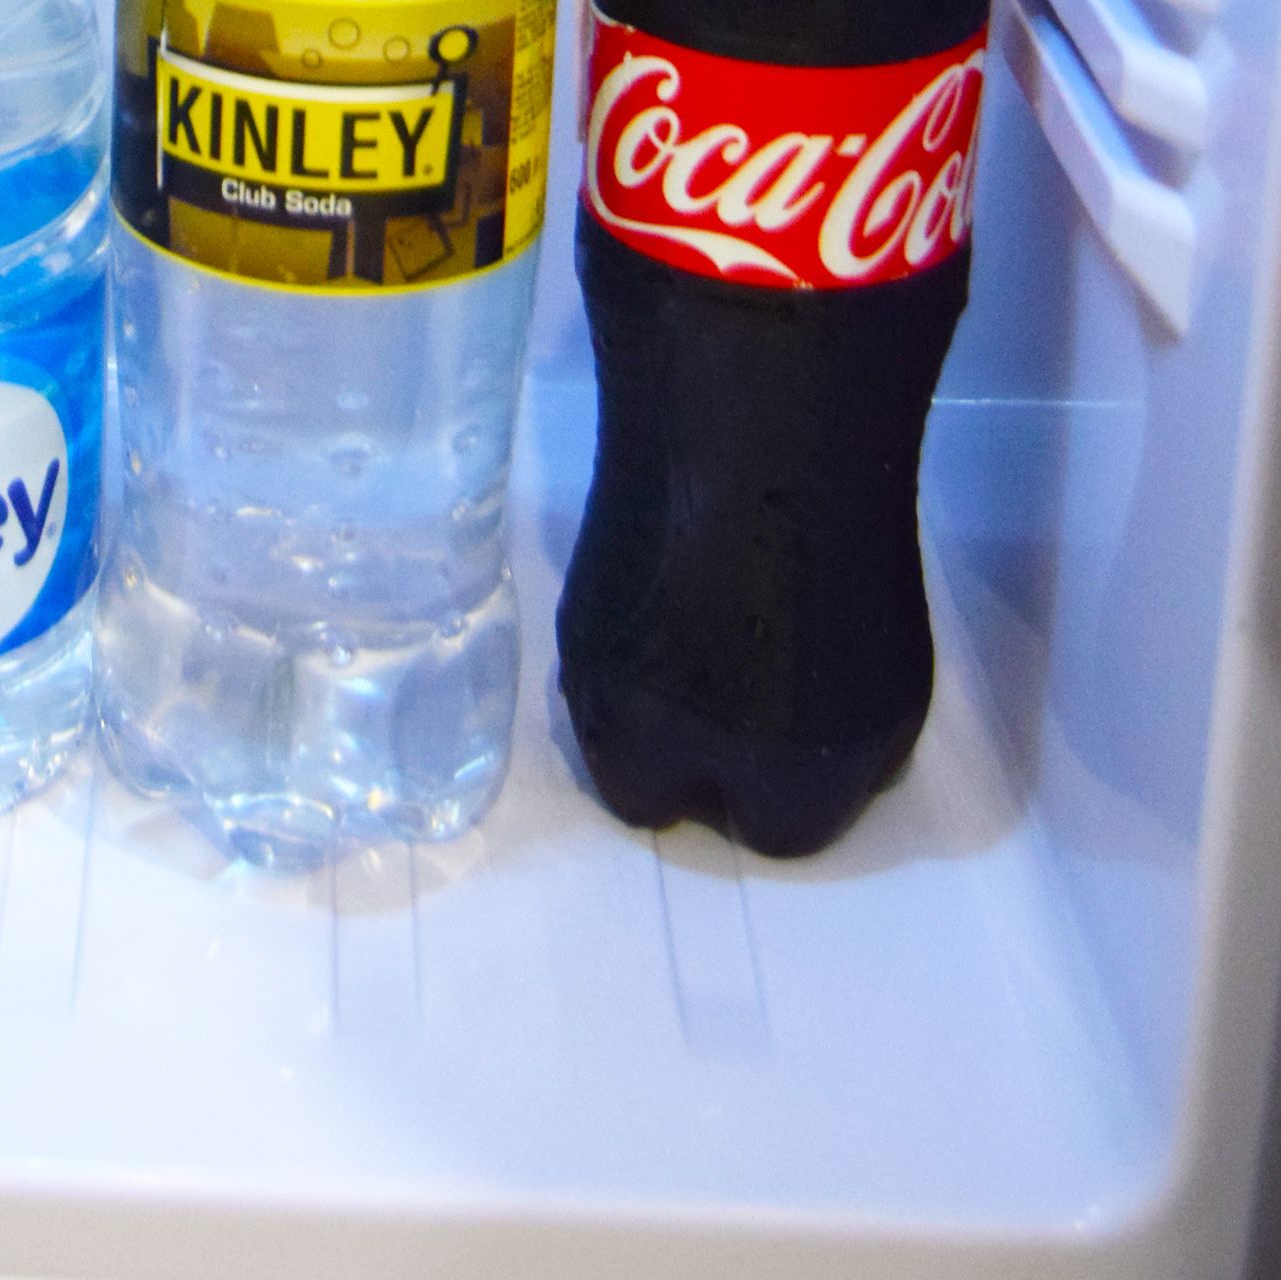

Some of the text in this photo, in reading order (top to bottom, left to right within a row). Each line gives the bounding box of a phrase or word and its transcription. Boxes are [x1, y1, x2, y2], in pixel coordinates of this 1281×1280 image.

[168, 77, 434, 181] KINLEY
[221, 177, 352, 216] Club Soda
